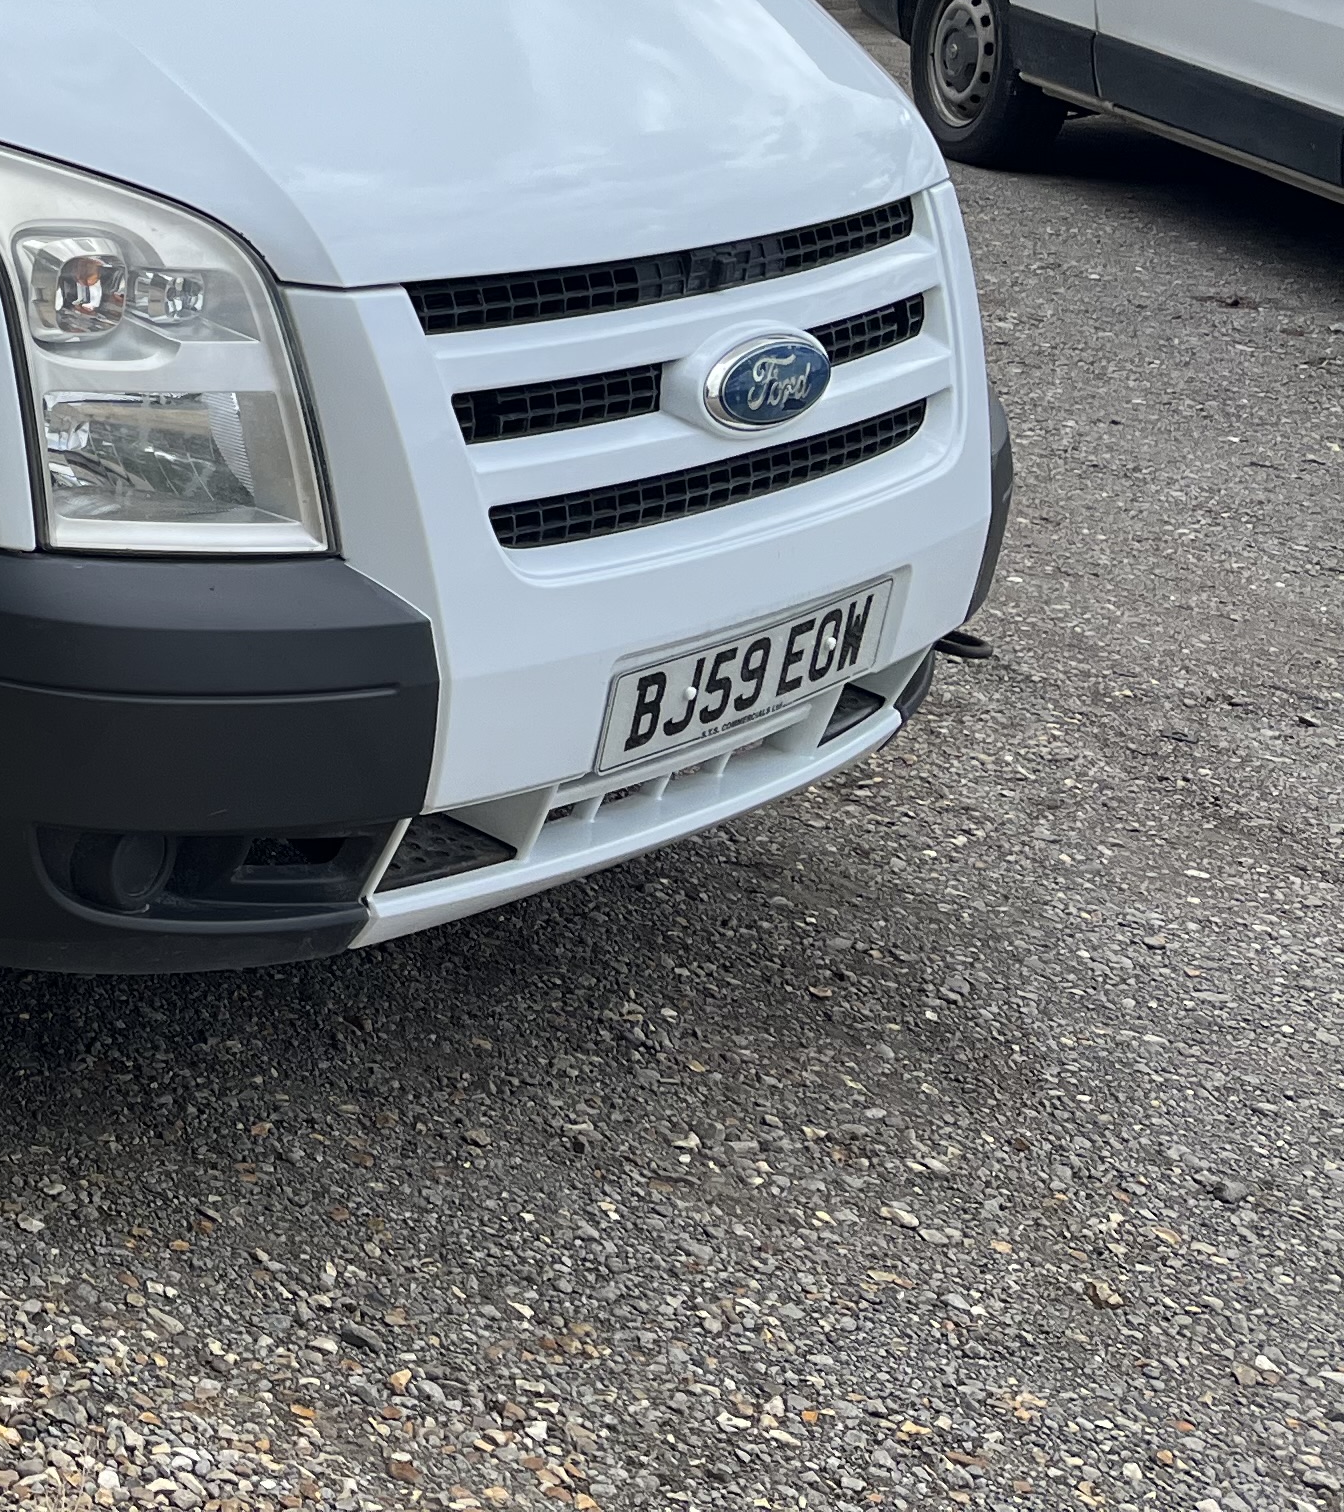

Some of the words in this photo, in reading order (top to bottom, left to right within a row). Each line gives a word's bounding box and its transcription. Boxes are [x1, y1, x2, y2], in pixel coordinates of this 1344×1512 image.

[747, 354, 811, 411] Ford
[624, 636, 772, 752] BJ59
[776, 593, 875, 697] EOW
[721, 705, 771, 732] COMMERCIALS
